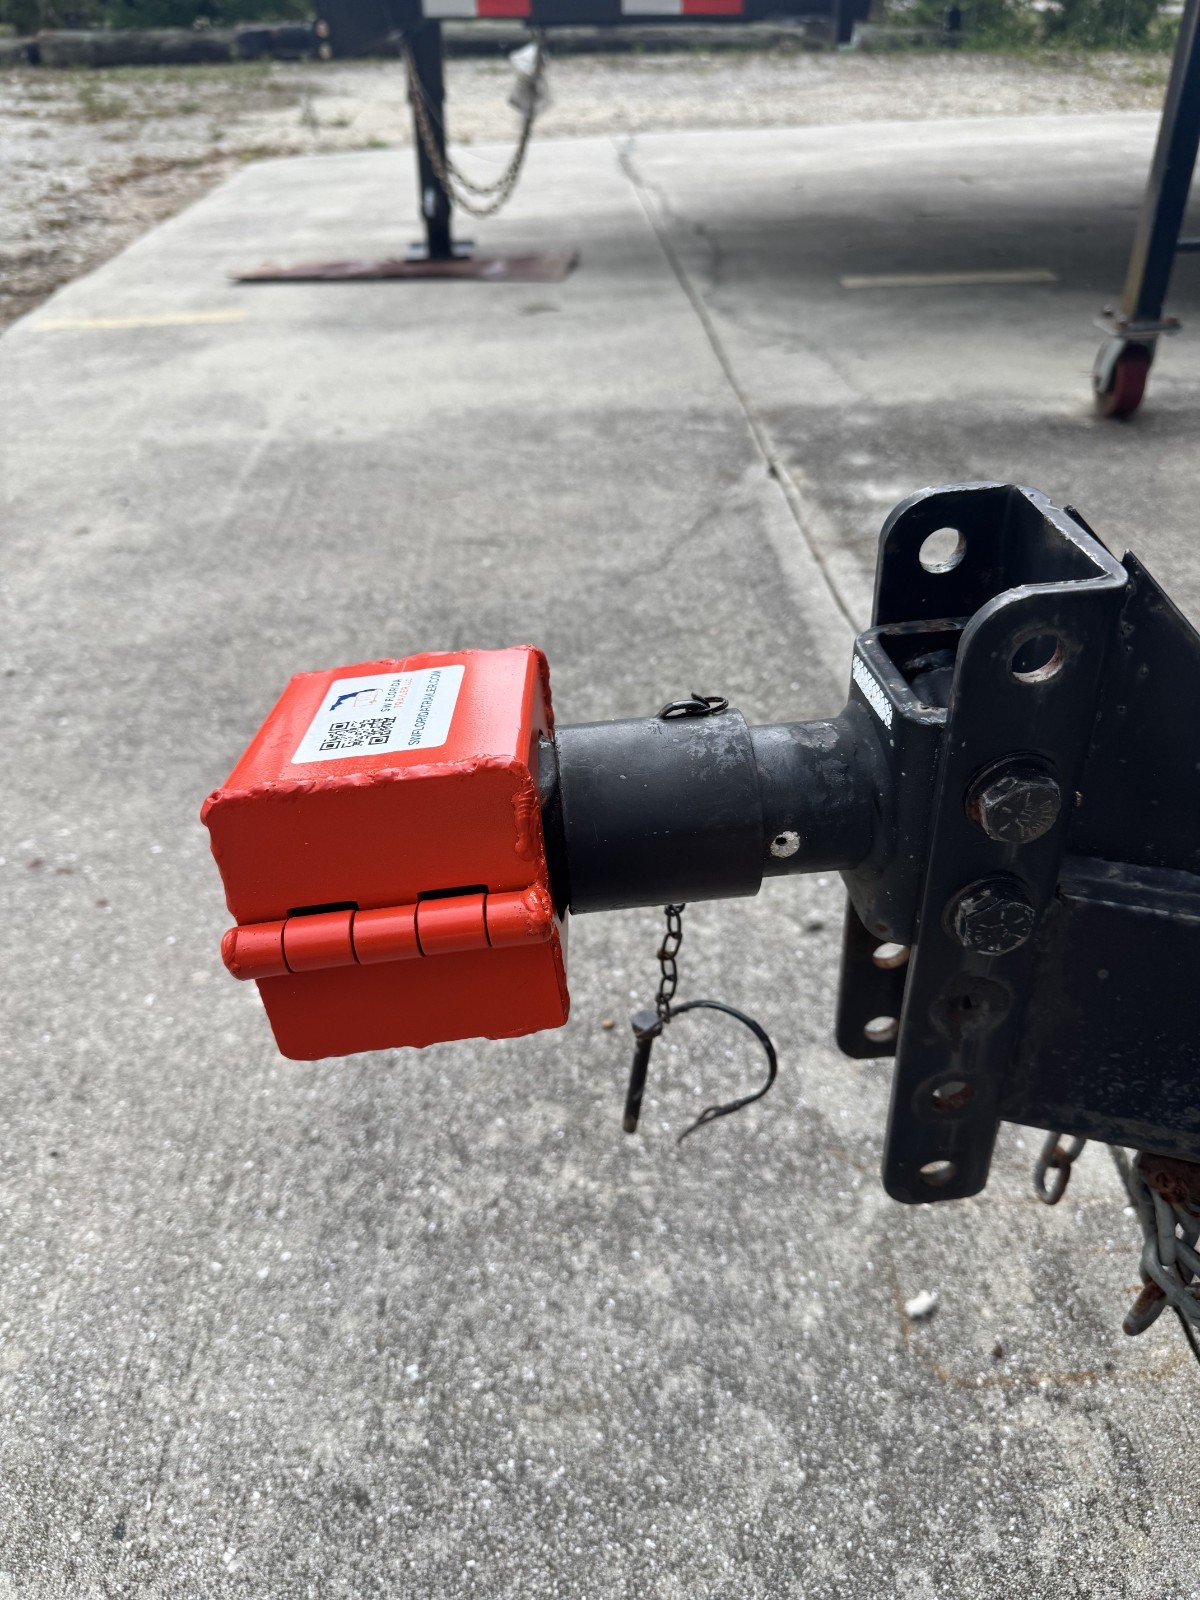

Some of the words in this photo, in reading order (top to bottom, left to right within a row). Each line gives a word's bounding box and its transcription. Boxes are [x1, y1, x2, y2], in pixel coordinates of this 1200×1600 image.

[384, 679, 402, 702] FLORIDA
[393, 686, 409, 709] TRAILER
[380, 703, 392, 712] SW
[408, 670, 442, 745] SWFLORIDATRAILER.COM
